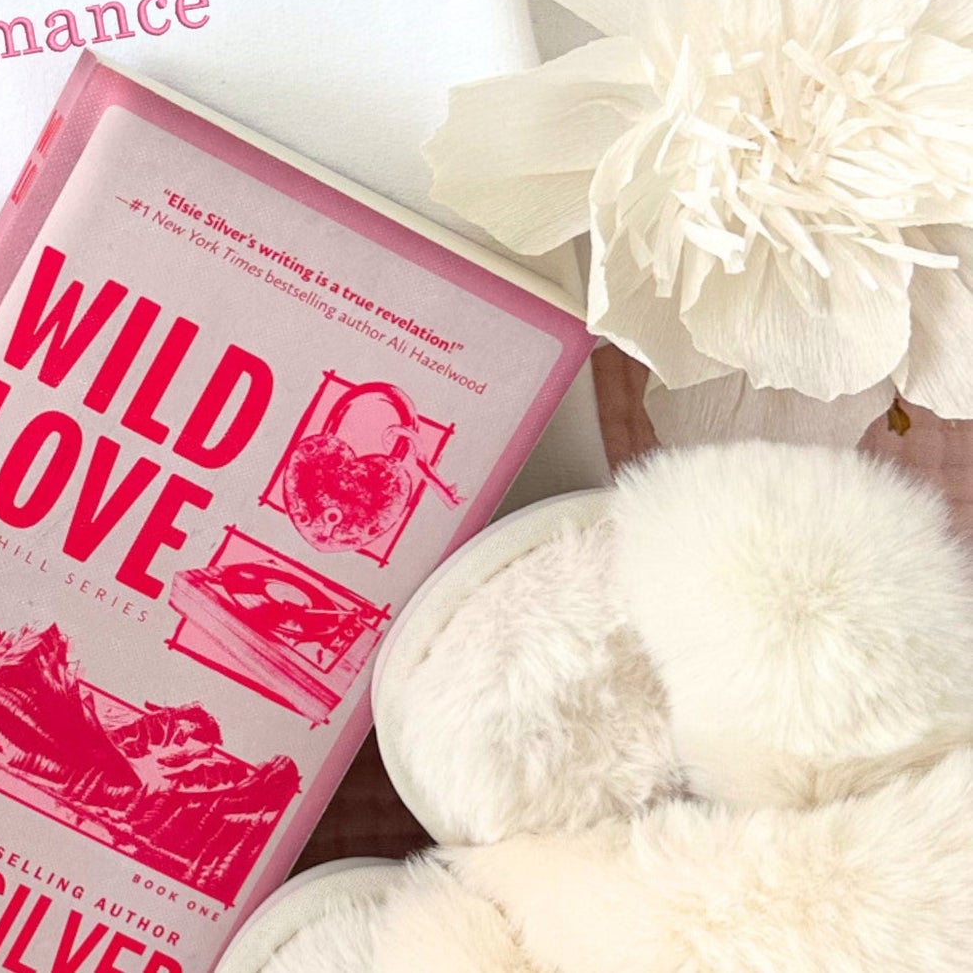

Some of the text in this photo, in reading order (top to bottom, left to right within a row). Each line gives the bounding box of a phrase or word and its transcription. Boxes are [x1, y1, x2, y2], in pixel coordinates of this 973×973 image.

[152, 210, 186, 236] New
[188, 228, 221, 255] York
[222, 246, 264, 278] Times
[264, 269, 337, 320] bestselling
[338, 310, 387, 343] author
[386, 336, 408, 355] Ali
[408, 346, 488, 396] Hazelwood
[258, 242, 314, 283] writing
[315, 271, 328, 287] is
[329, 281, 340, 294] a
[342, 287, 375, 312] true
[3, 245, 274, 470] WILD
[64, 572, 150, 624] SERIES
[94, 897, 181, 947] AUTHOR
[131, 873, 221, 923] BOOK ONE
